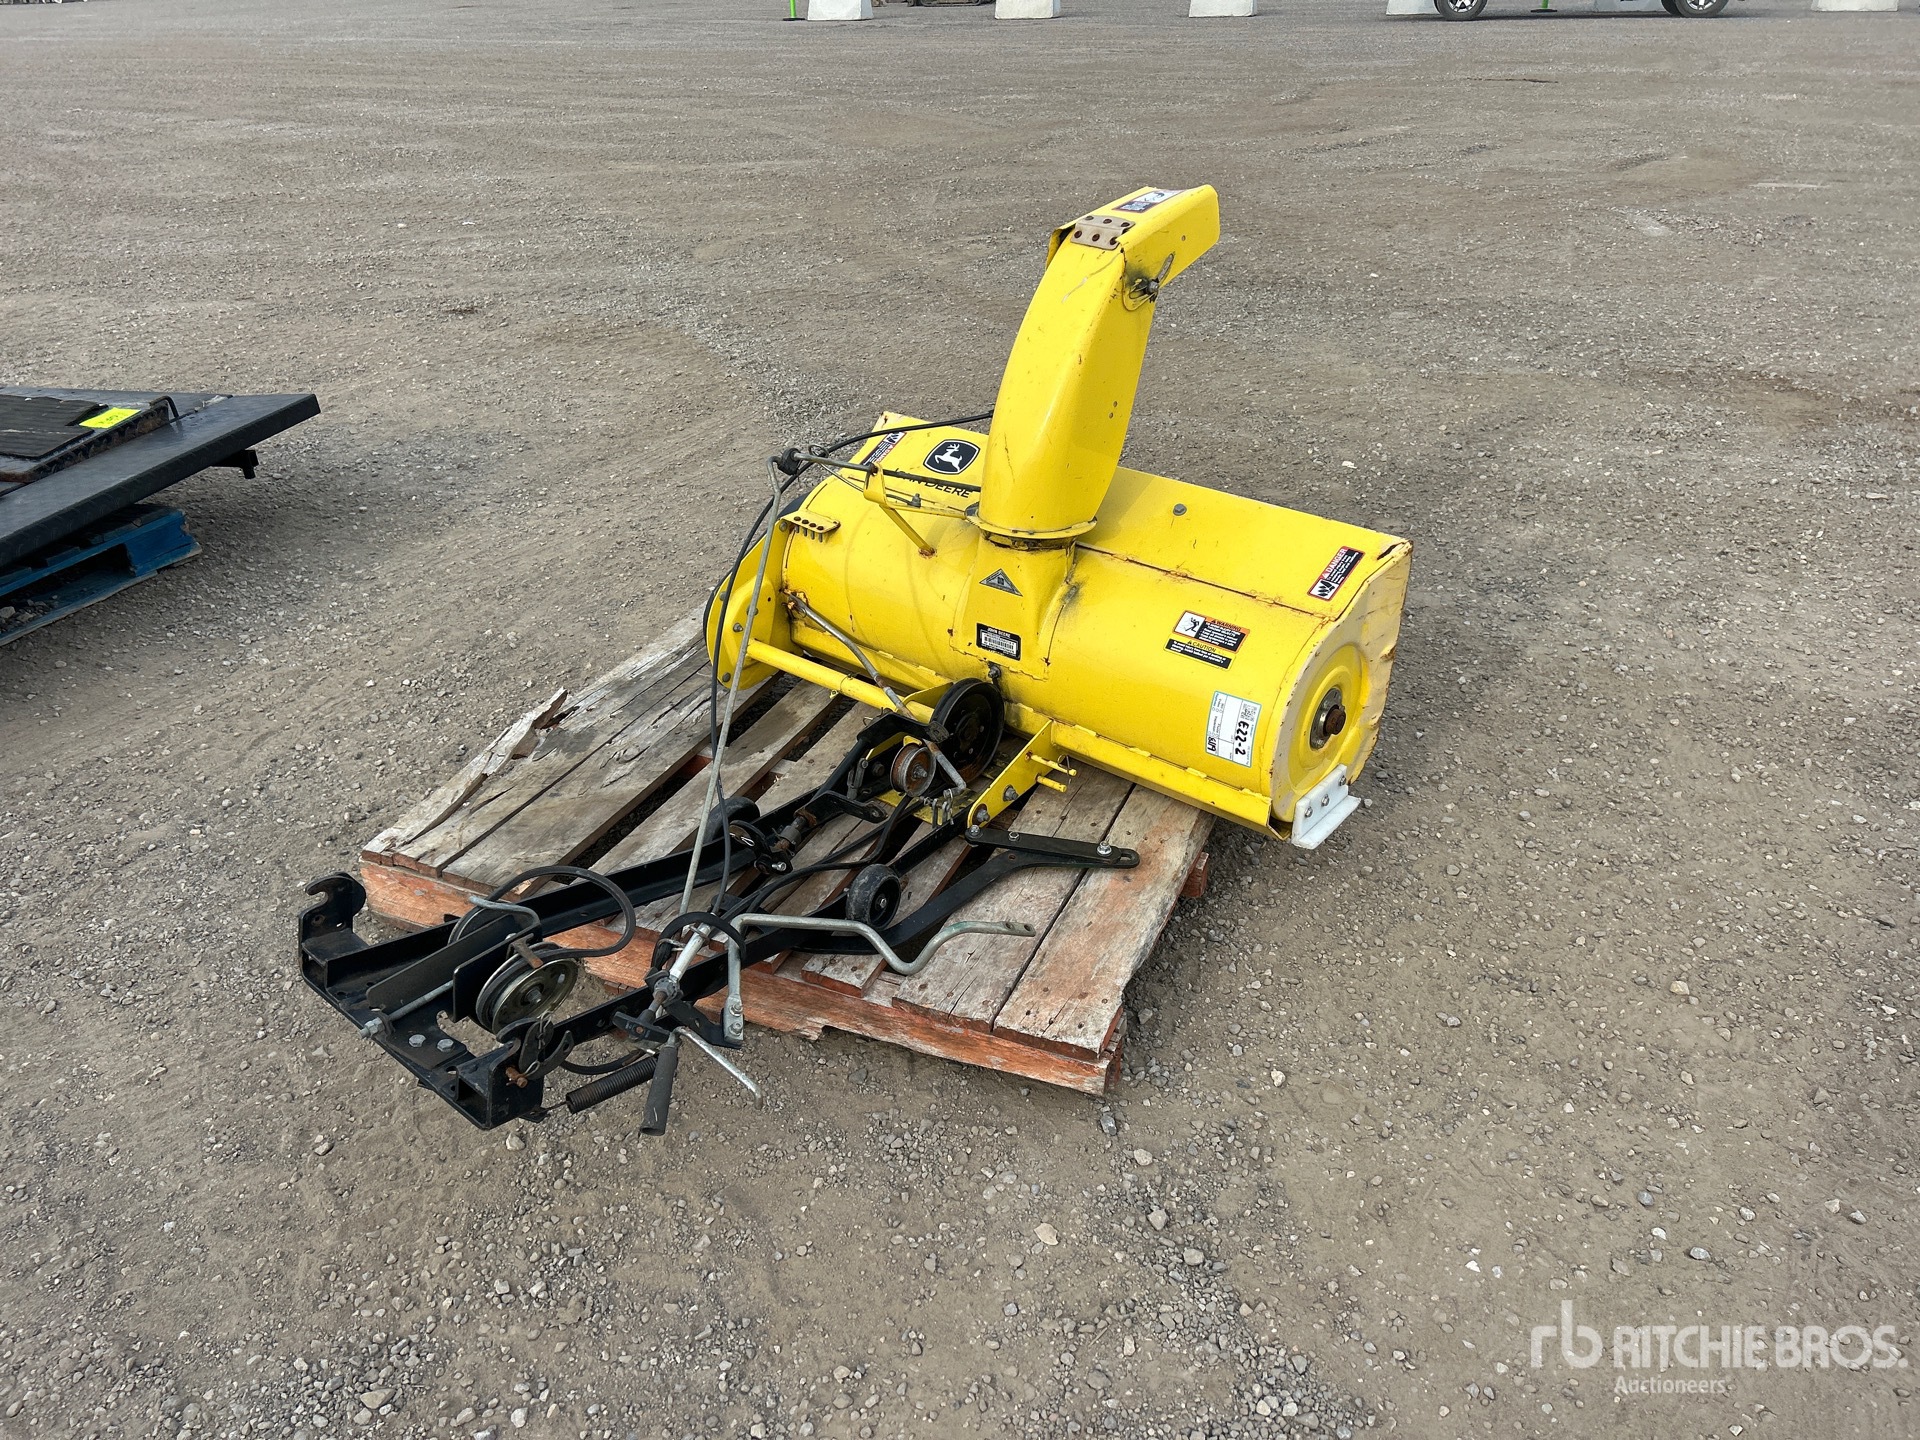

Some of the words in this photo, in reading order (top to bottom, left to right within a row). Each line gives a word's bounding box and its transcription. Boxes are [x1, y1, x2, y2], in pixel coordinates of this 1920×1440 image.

[1326, 549, 1347, 573] DANGER
[1216, 620, 1242, 632] WARNING
[1192, 641, 1217, 653] CAUTION
[1234, 720, 1250, 756] E22-2
